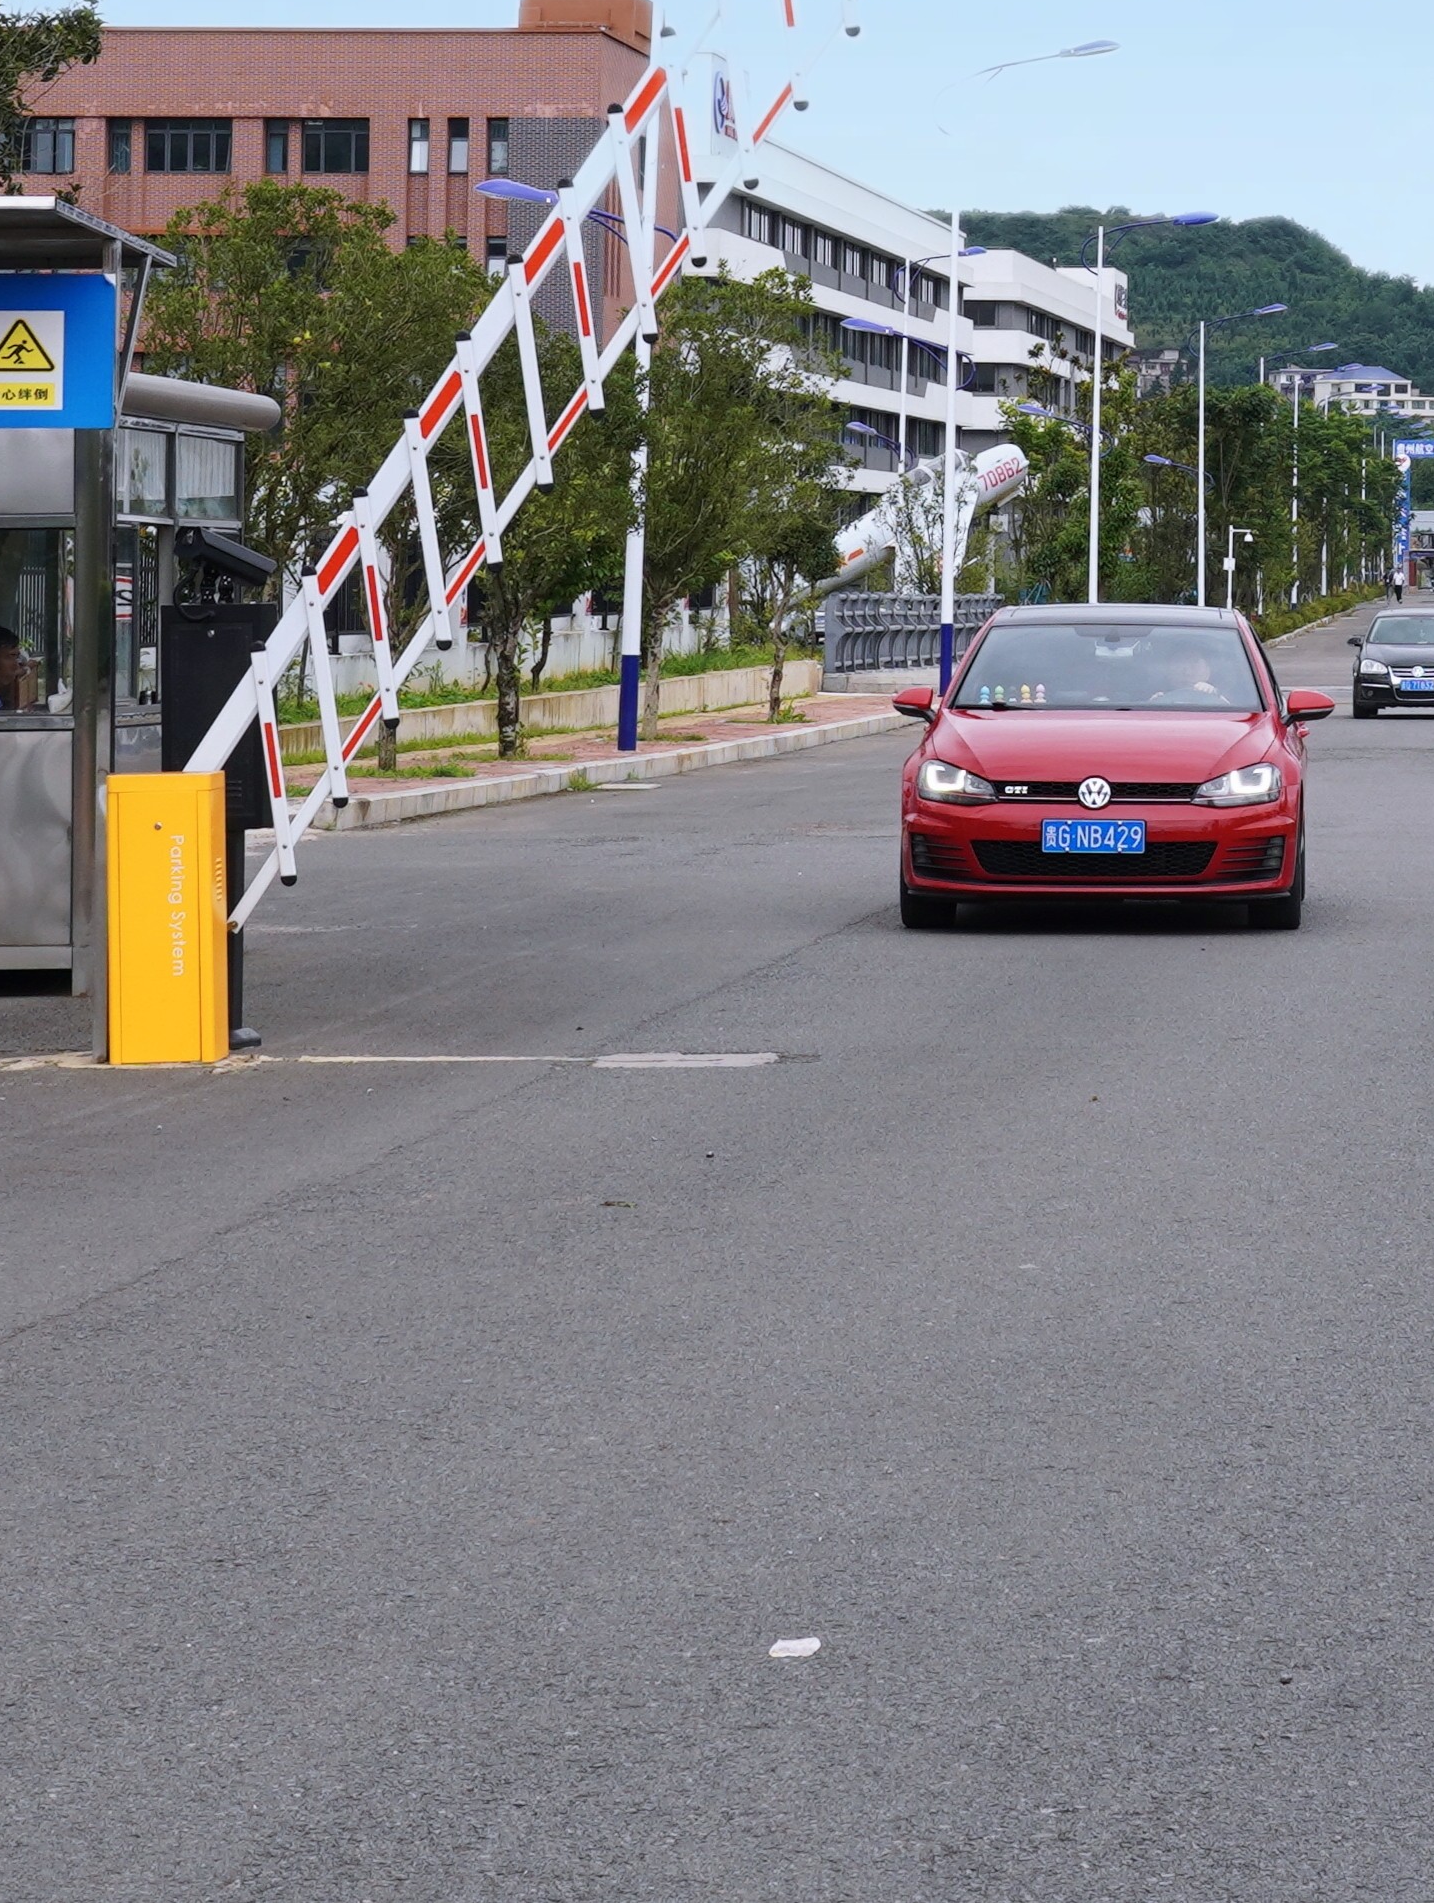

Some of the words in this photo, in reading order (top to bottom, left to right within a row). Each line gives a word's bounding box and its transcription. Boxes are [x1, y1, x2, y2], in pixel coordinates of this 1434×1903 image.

[977, 457, 1023, 492] 70862
[1004, 785, 1029, 794] GTI
[168, 835, 185, 904] Parking
[168, 911, 186, 977] System
